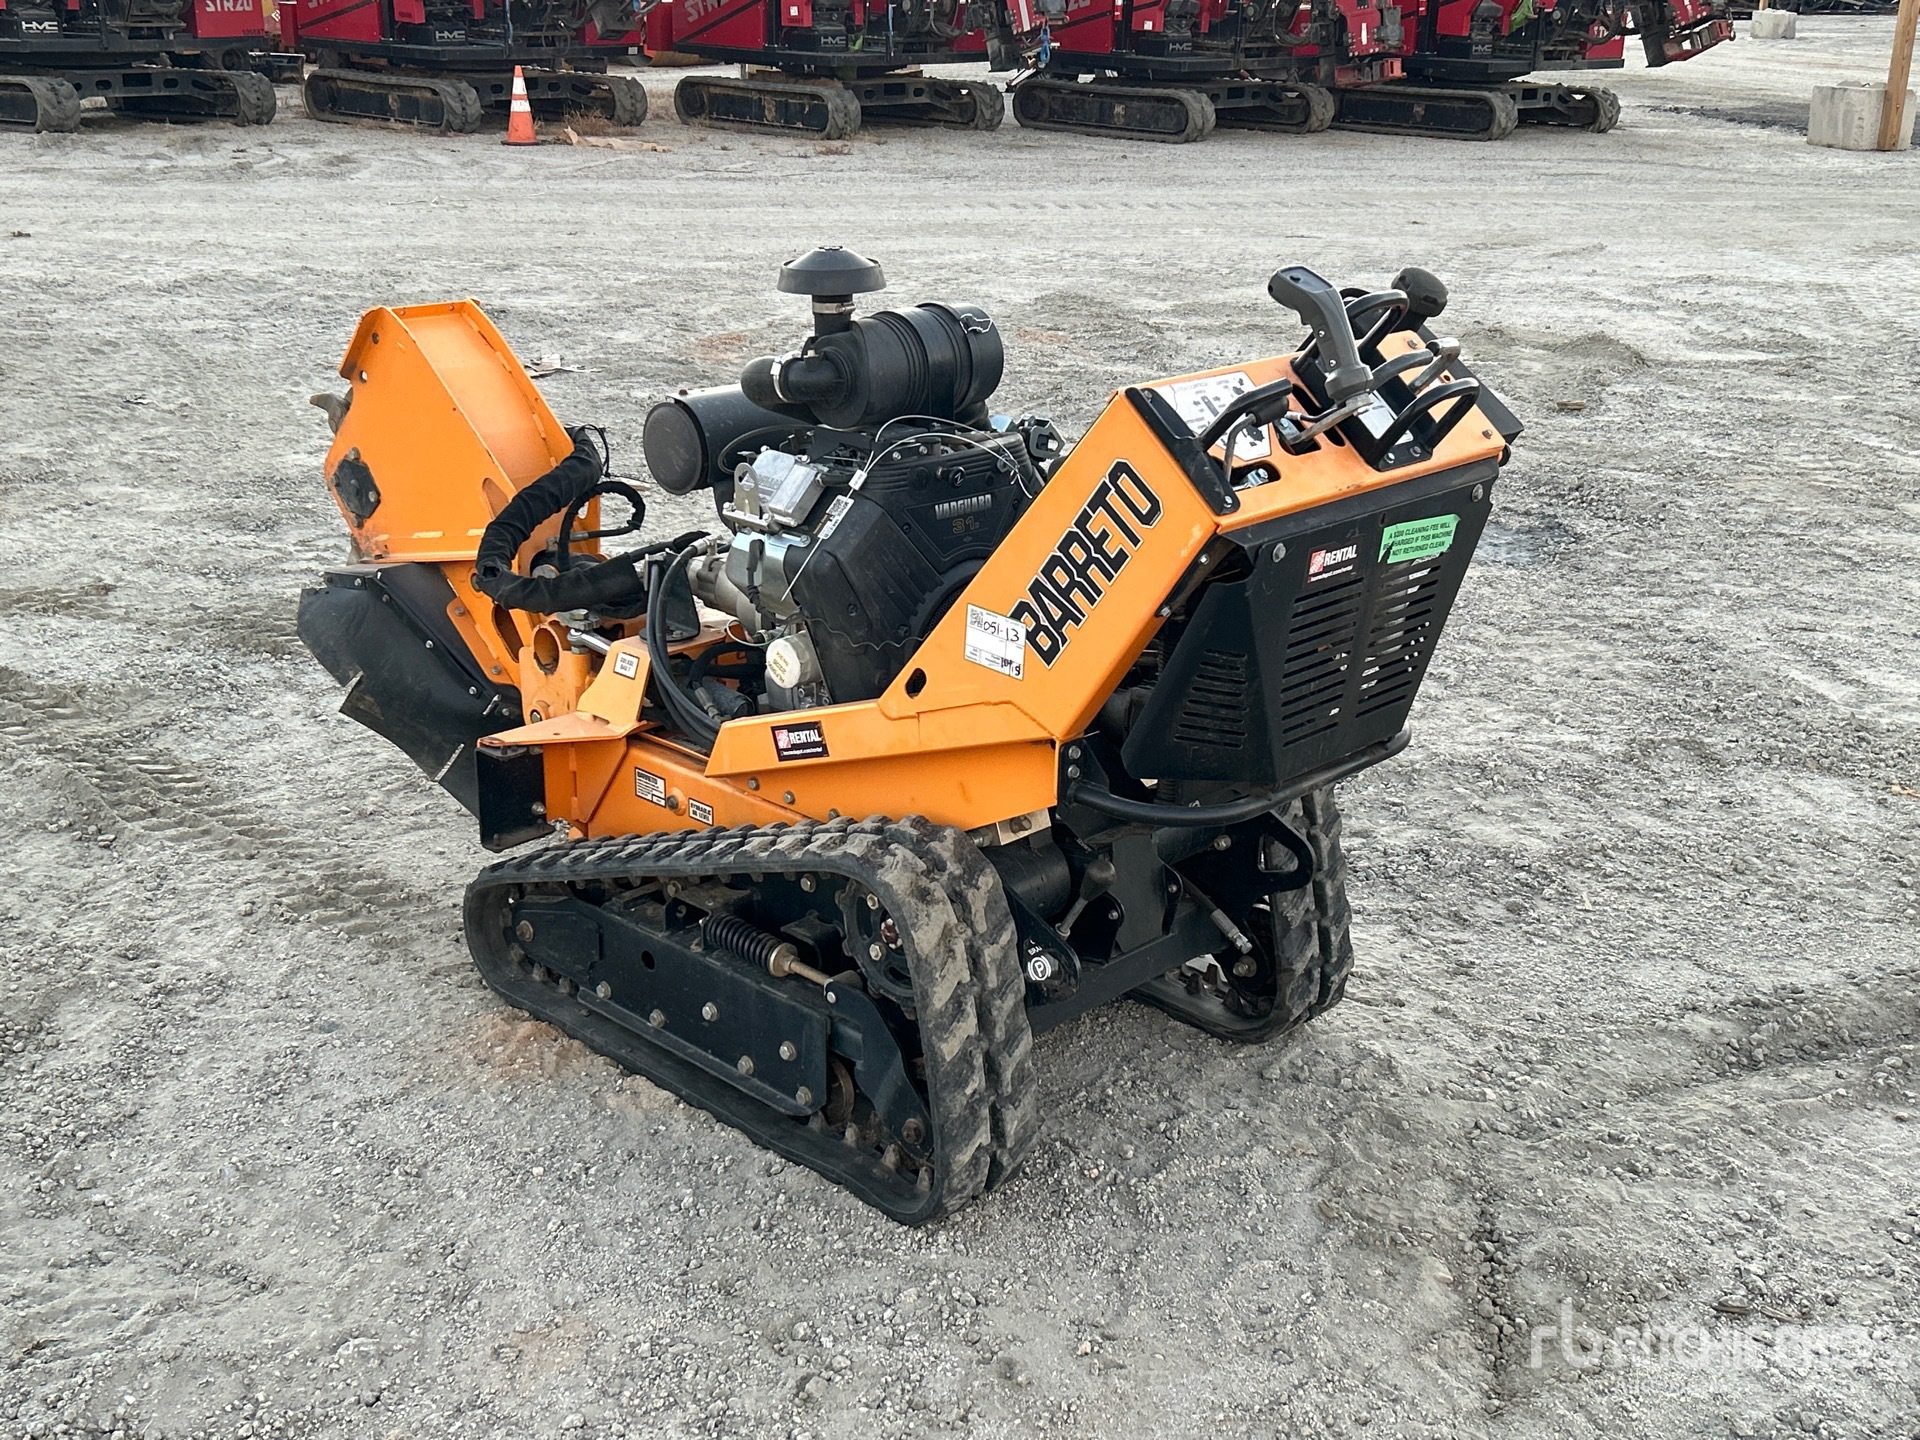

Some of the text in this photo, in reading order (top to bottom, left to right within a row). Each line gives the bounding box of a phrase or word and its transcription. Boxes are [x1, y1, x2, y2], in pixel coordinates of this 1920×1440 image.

[934, 493, 993, 520] VANGUARD
[1404, 526, 1430, 536] CLEANING
[1430, 523, 1440, 531] FEE
[1440, 521, 1451, 529] WILL
[1431, 529, 1453, 540] MACHINE
[1402, 544, 1429, 554] RETURNED
[1428, 540, 1446, 549] CLEAN
[1007, 458, 1164, 669] BARRETO
[1323, 544, 1358, 567] RENTAL
[788, 729, 823, 745] RENTAL
